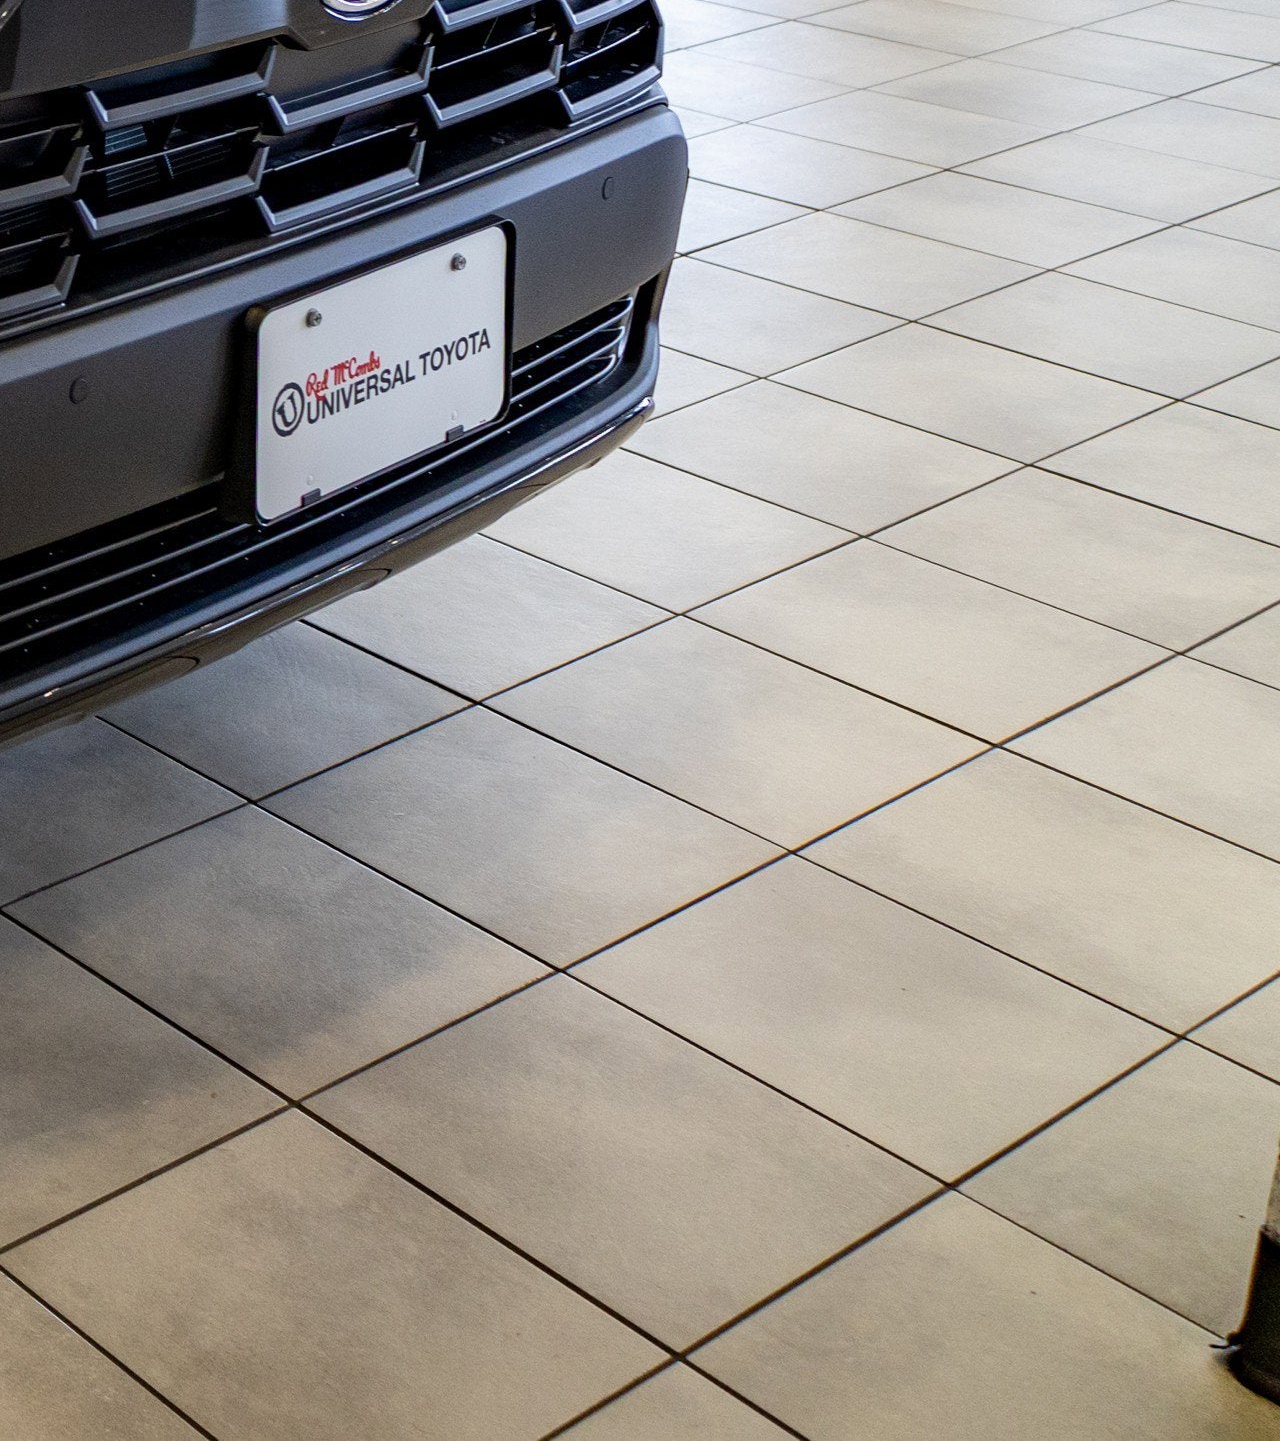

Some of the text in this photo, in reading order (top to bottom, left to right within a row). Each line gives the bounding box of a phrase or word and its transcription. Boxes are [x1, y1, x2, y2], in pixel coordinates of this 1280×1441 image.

[306, 328, 491, 425] UNIVERSAL TOYOTA
[306, 368, 329, 400] Red
